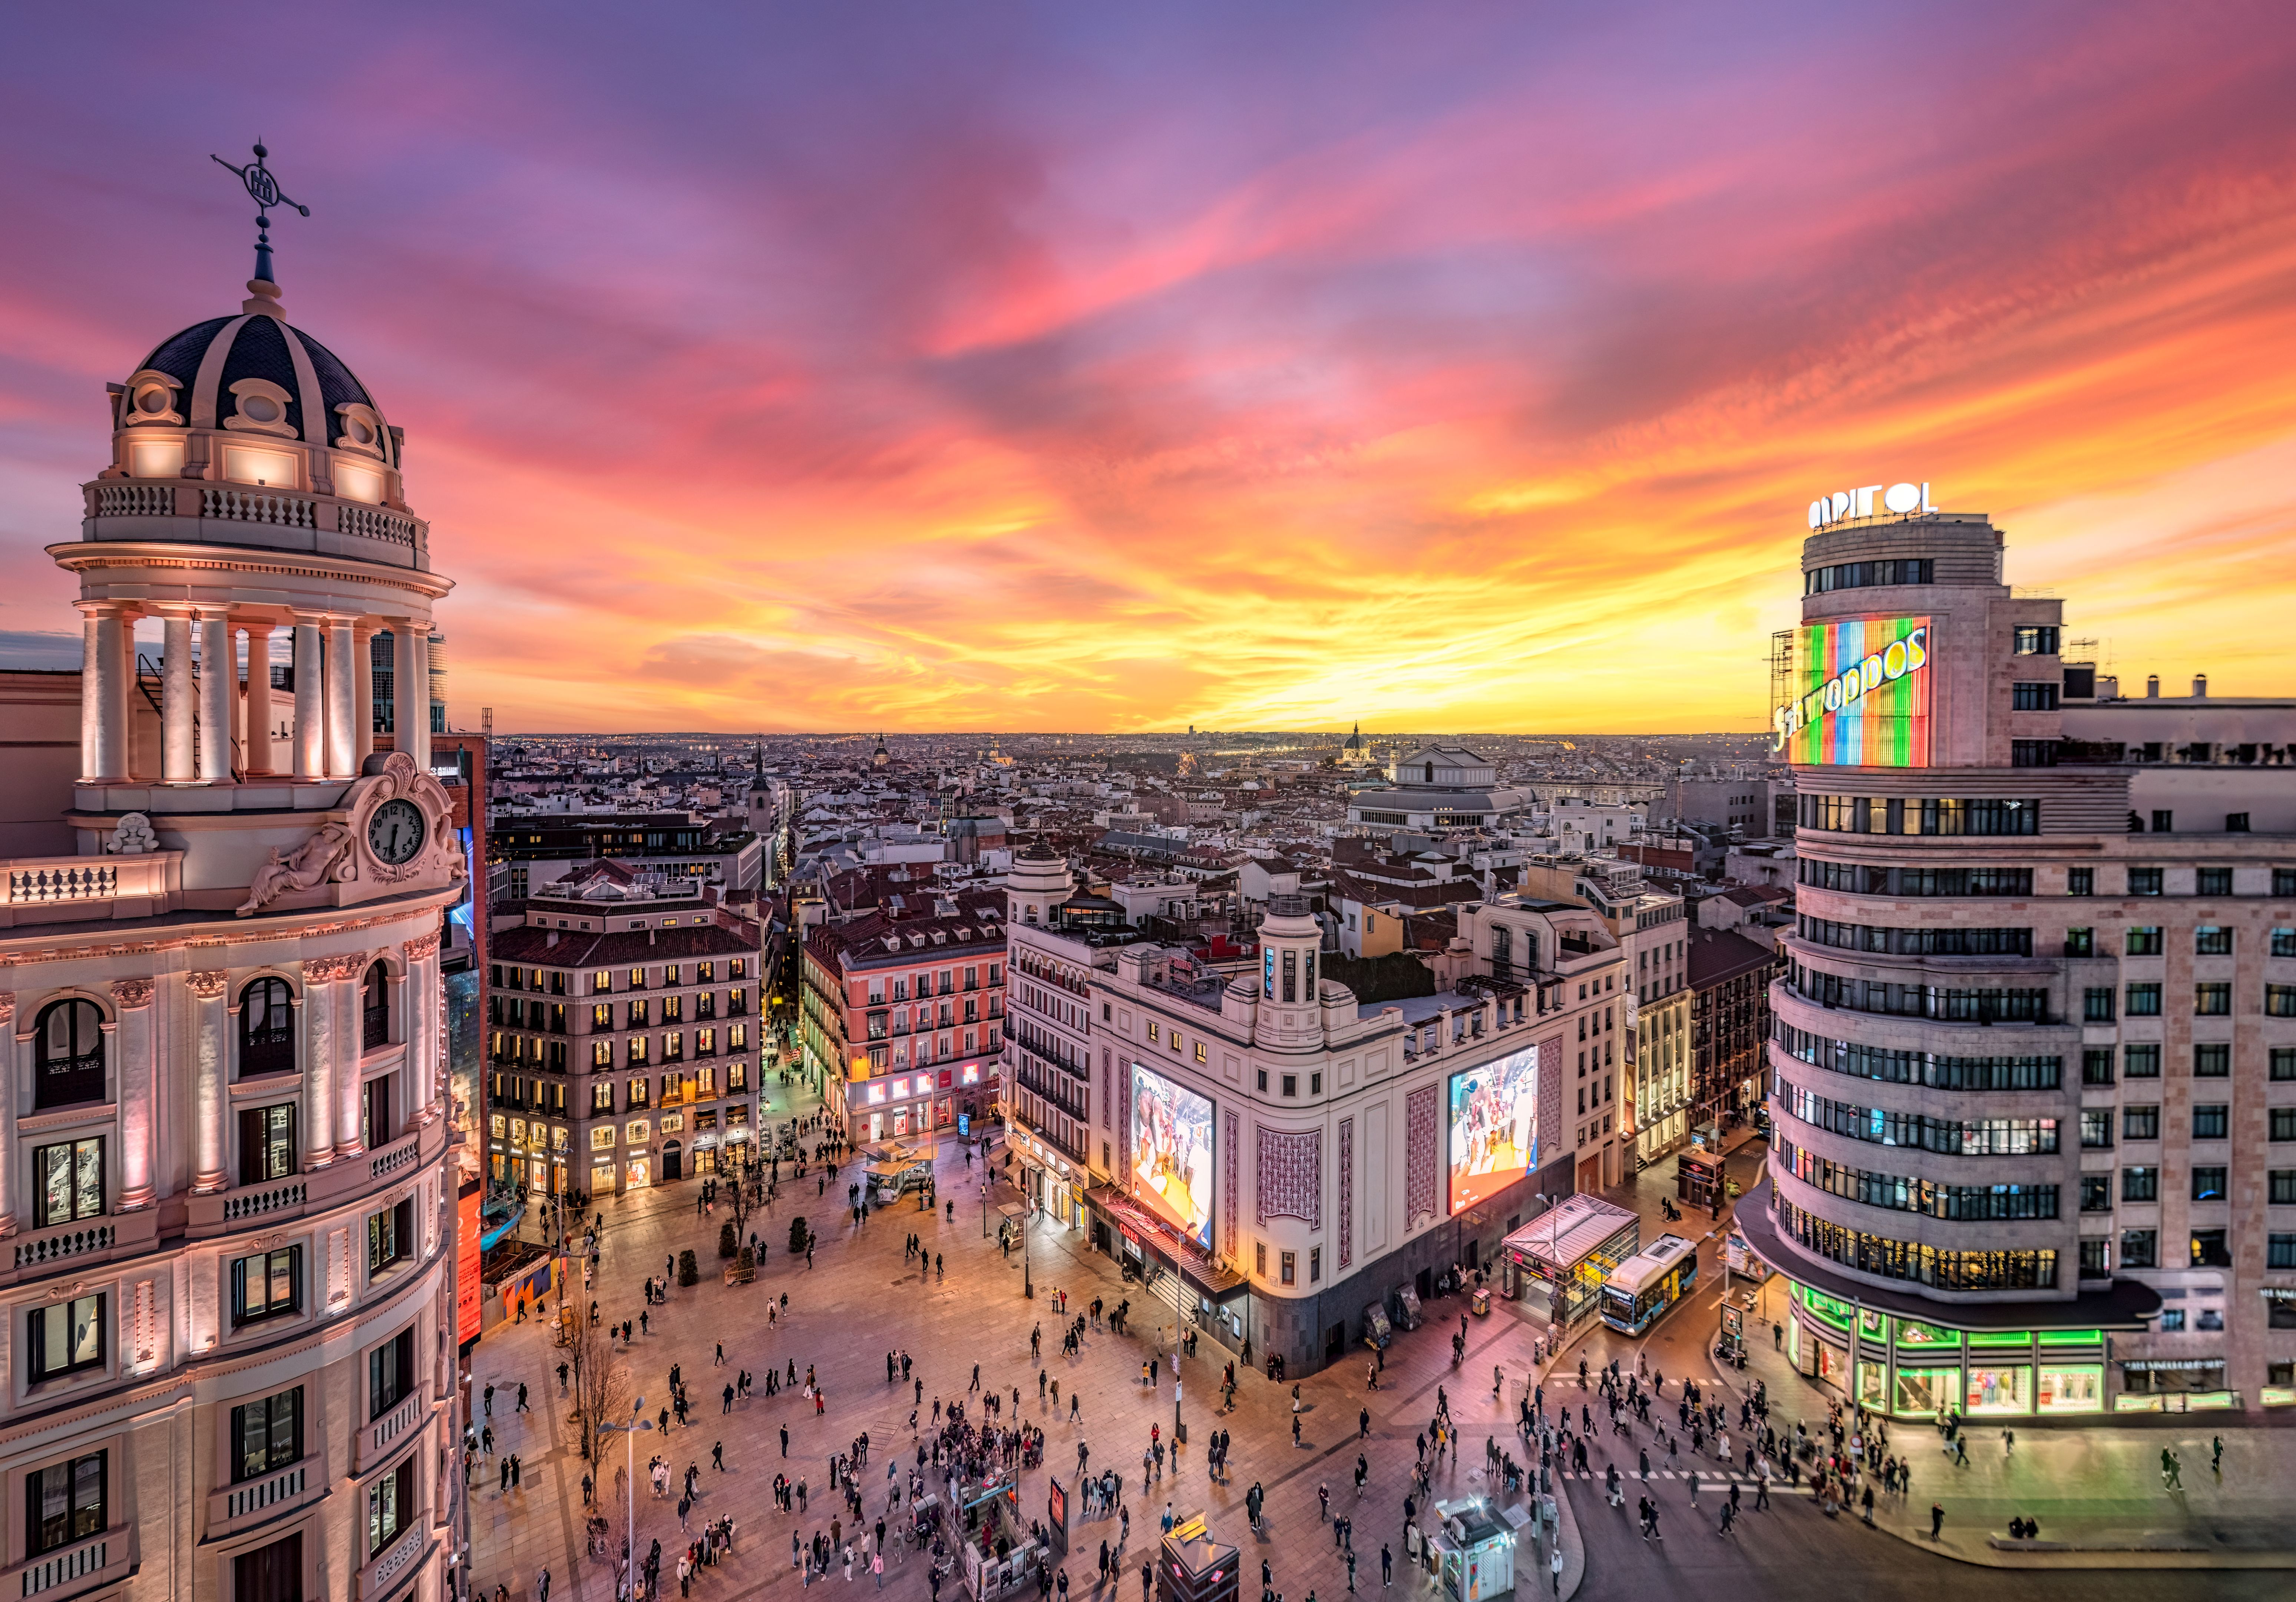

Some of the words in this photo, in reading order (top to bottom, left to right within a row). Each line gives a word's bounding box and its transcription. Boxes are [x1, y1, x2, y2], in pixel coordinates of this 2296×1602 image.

[382, 810, 387, 819] 11
[390, 806, 398, 815] 12
[402, 808, 405, 817] 1
[374, 819, 382, 828] 10
[409, 816, 413, 825] 2
[412, 825, 416, 834] 3
[371, 830, 376, 839] 9
[375, 840, 380, 849] 8
[407, 837, 412, 846] 4
[383, 847, 388, 857] 7
[402, 844, 407, 853] 5
[1119, 1223, 1139, 1244] CINES
